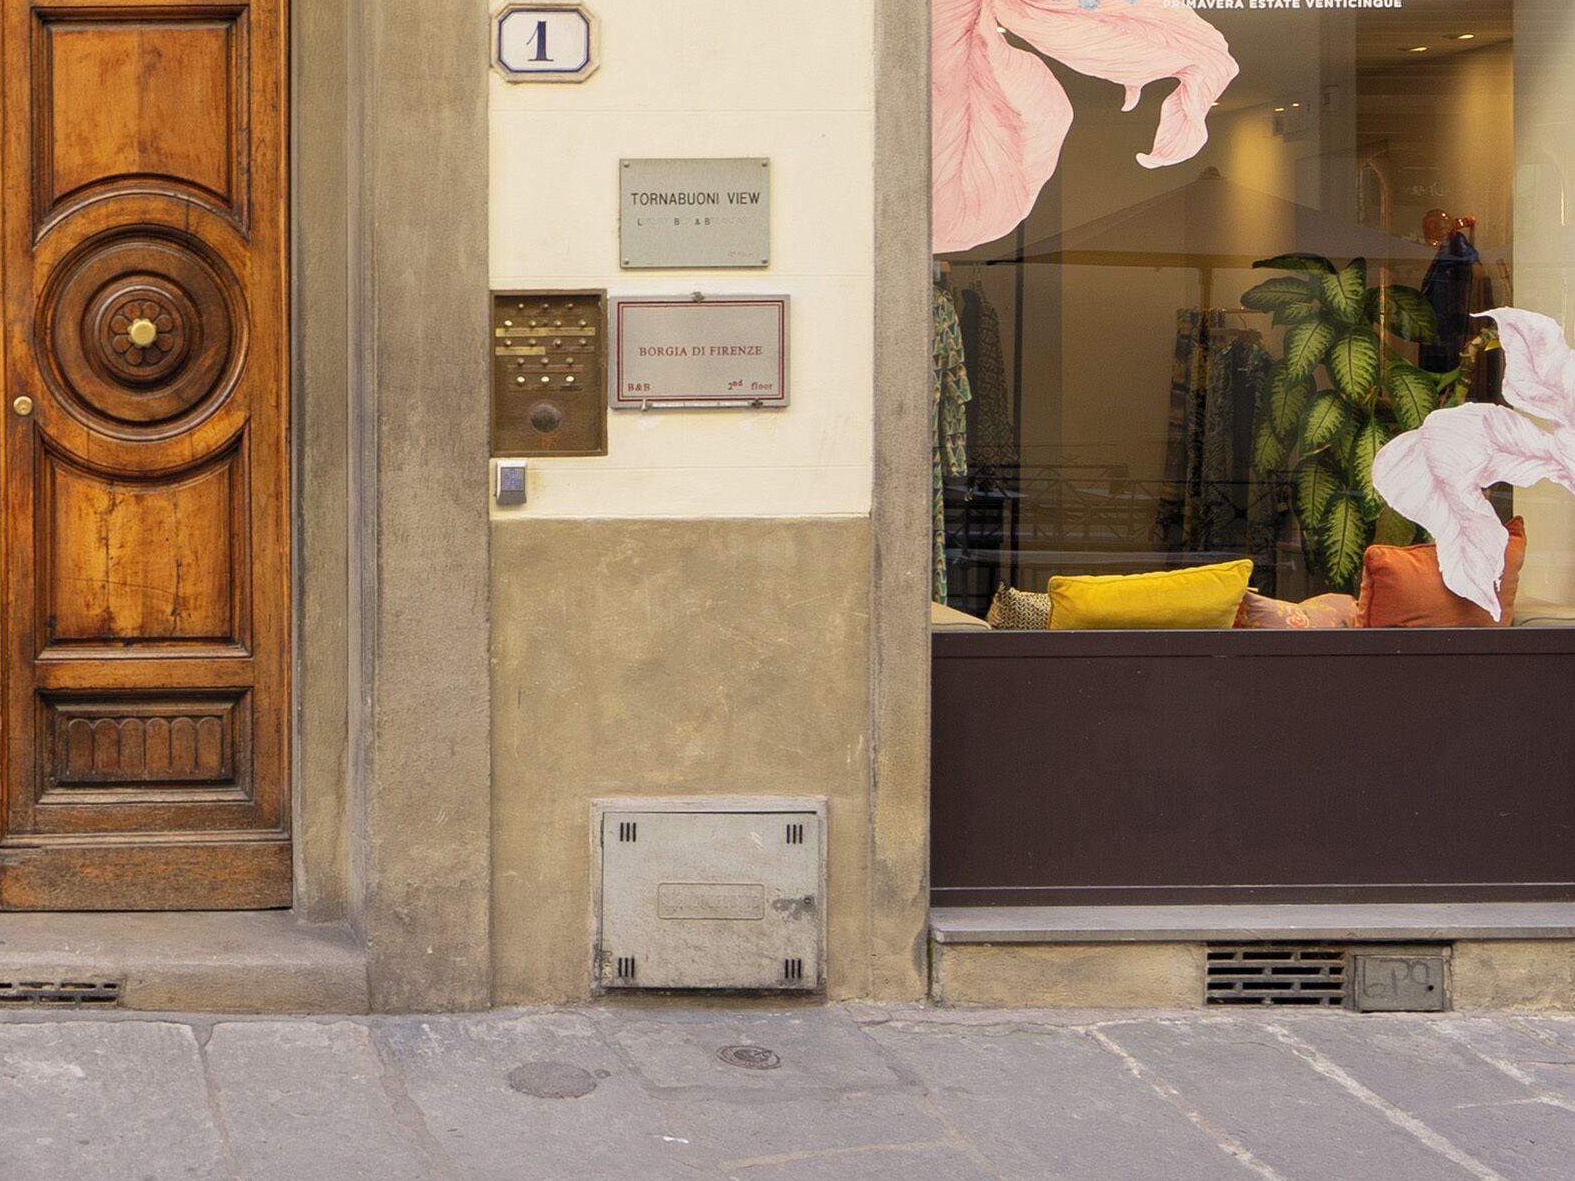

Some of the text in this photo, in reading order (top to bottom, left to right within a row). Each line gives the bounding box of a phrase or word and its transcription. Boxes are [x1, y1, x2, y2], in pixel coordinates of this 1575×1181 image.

[526, 20, 554, 62] 1
[631, 191, 761, 205] TORNABUONI VIEW
[639, 345, 763, 357] BORGIA DI FIRENZE
[627, 382, 650, 392] B&B
[751, 381, 773, 391] floor
